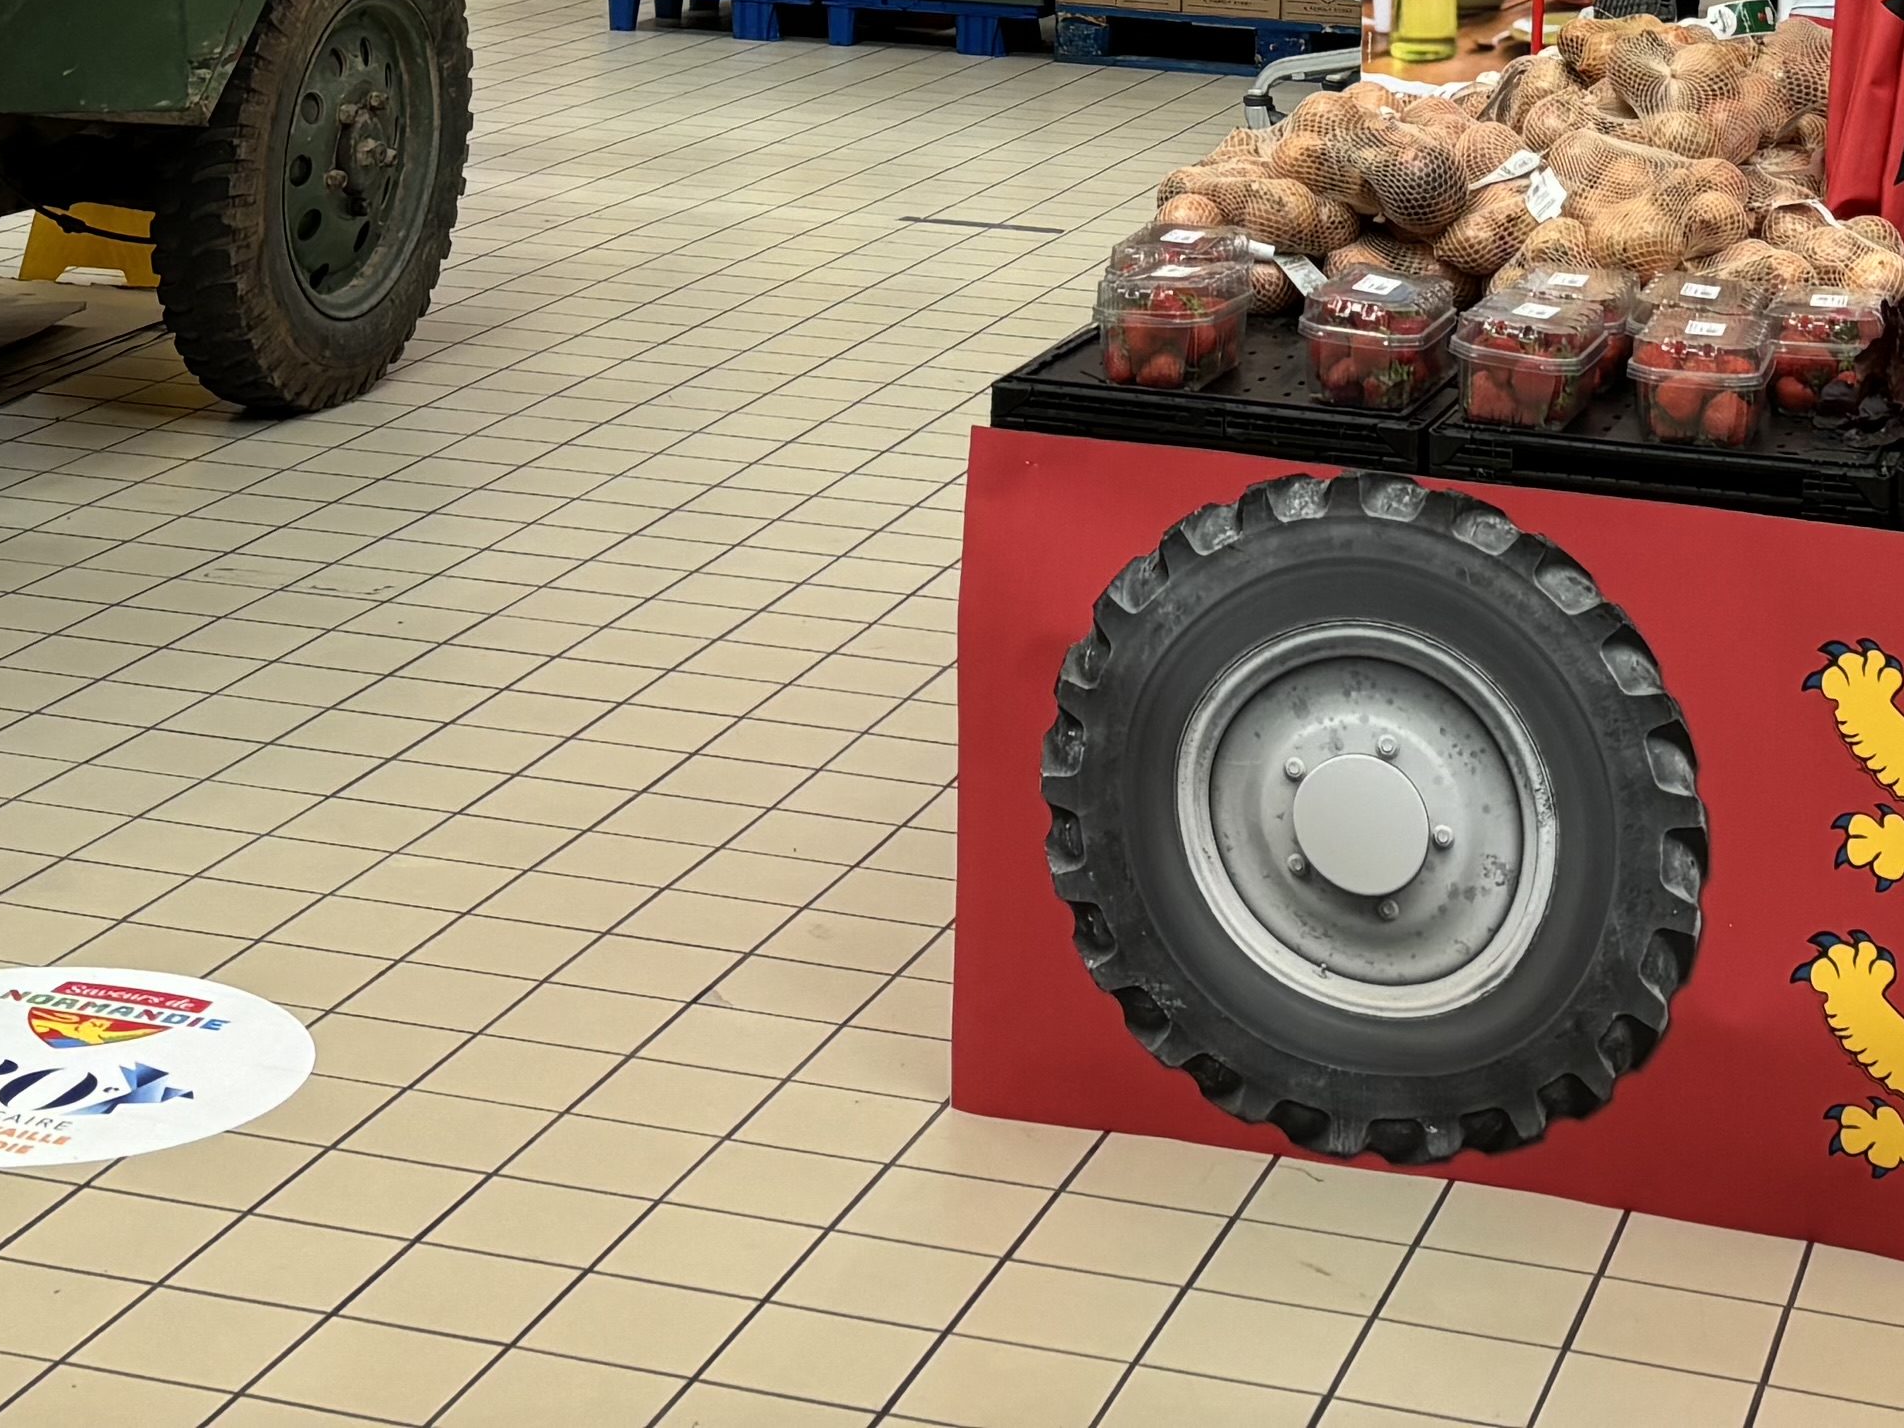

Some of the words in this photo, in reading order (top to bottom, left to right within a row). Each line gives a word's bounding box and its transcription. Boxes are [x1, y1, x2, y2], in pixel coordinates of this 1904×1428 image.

[0, 989, 232, 1033] NORMANDIE
[66, 982, 165, 1006] Saveurs
[167, 995, 196, 1012] de
